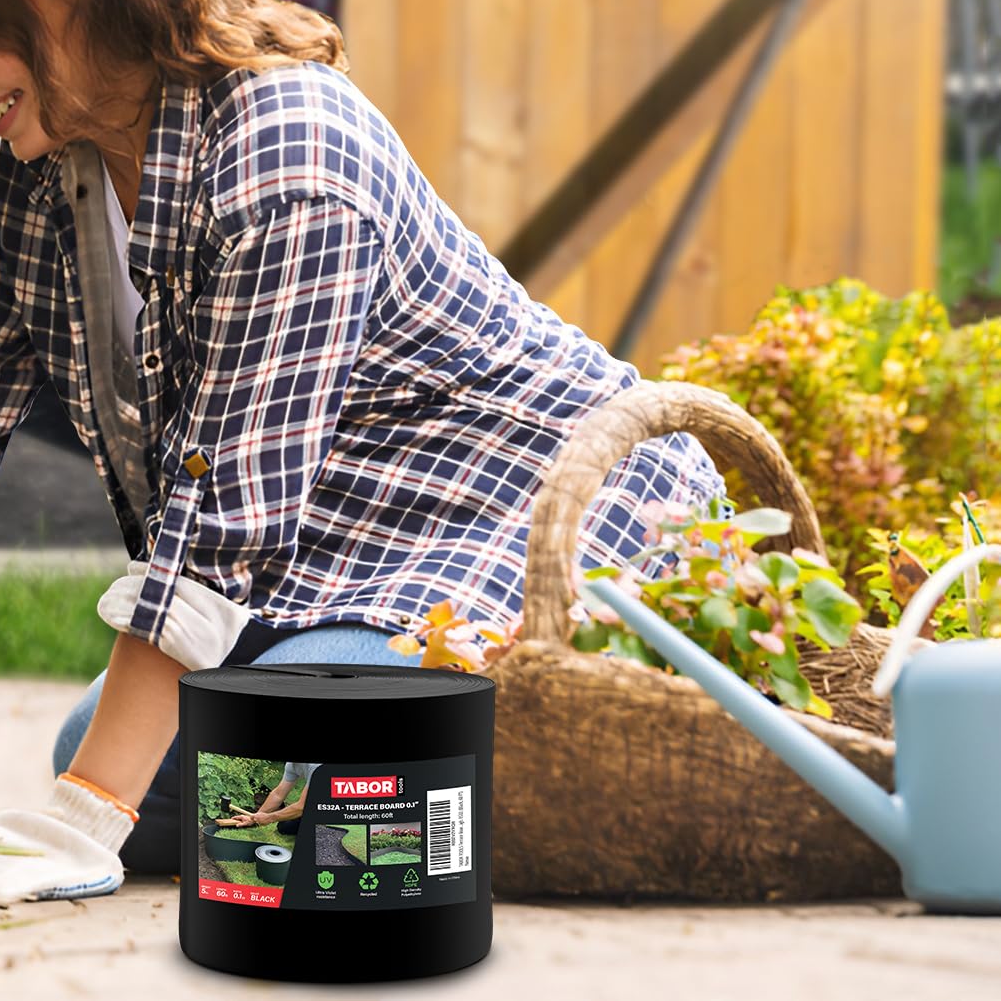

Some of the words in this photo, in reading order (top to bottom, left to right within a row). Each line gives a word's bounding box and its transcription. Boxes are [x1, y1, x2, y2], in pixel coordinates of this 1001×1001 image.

[334, 780, 394, 795] TABOR
[345, 803, 379, 811] TERRACE
[379, 802, 406, 811] BOARD
[359, 812, 381, 821] length:
[319, 876, 333, 884] UV
[250, 894, 276, 903] BLACK
